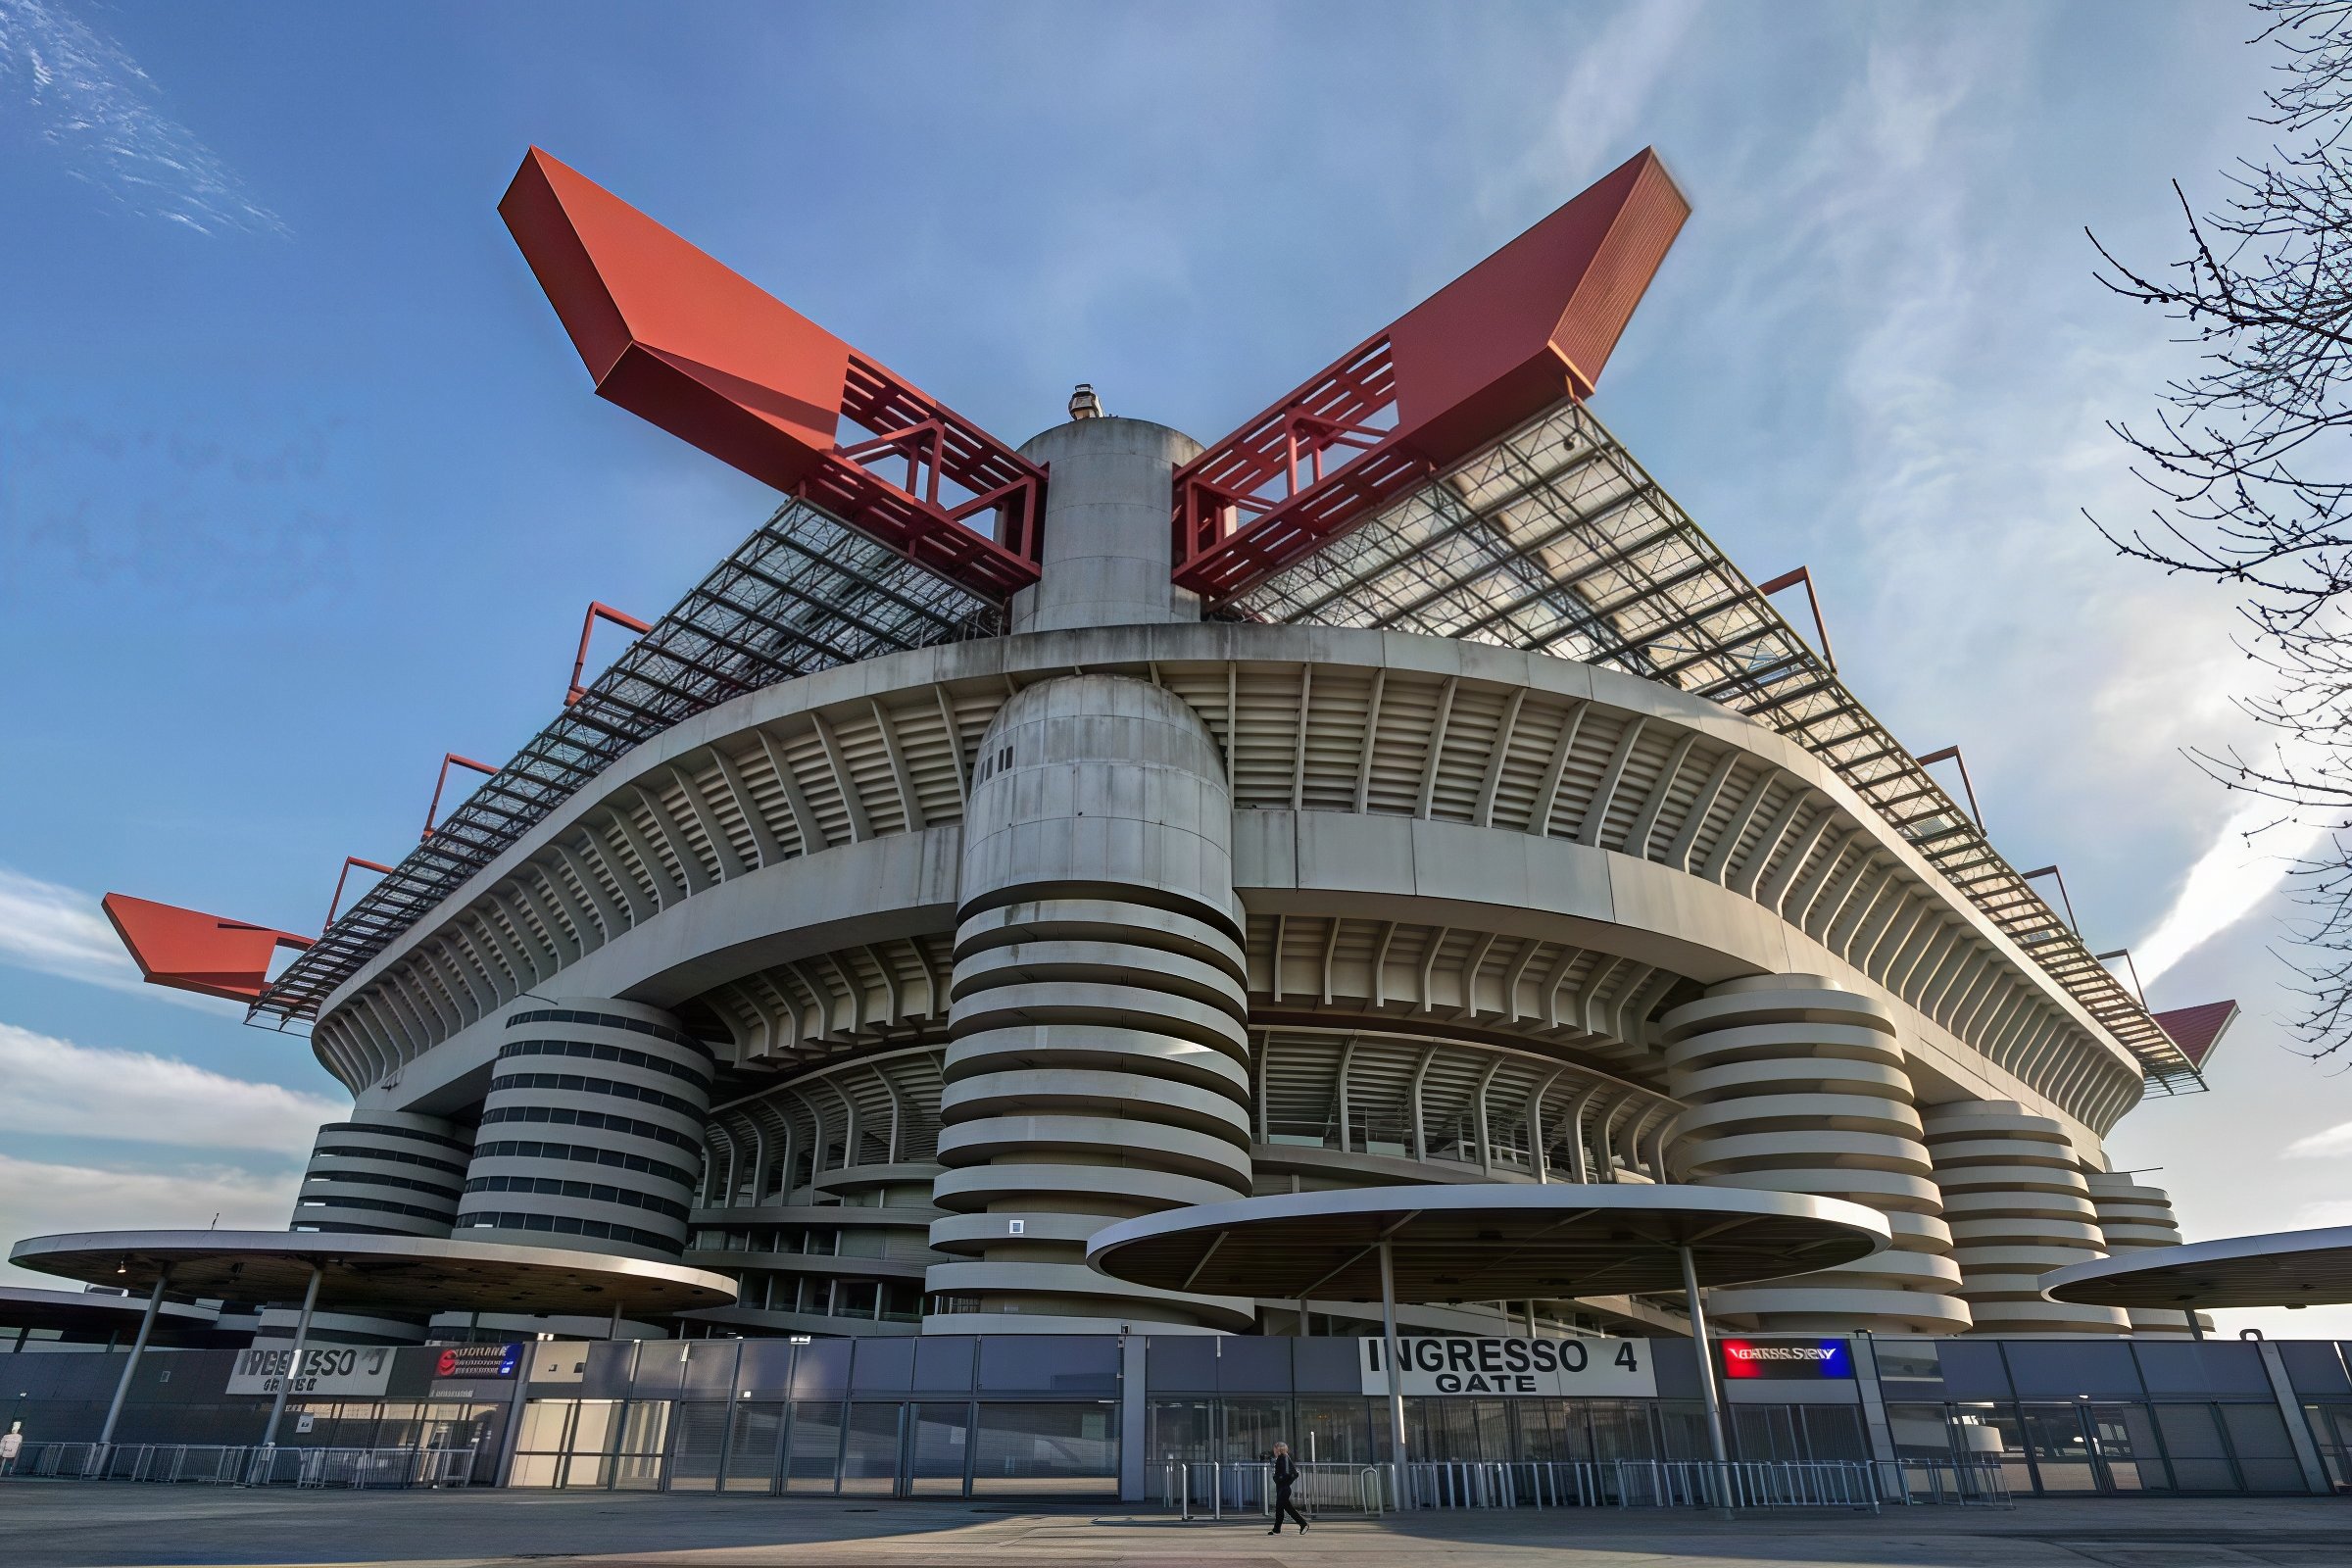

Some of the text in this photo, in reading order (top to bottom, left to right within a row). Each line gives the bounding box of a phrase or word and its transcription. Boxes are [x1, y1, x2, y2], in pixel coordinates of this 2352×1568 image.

[1368, 1339, 1637, 1372] INGRESSO 4
[1436, 1374, 1536, 1393] GATE
